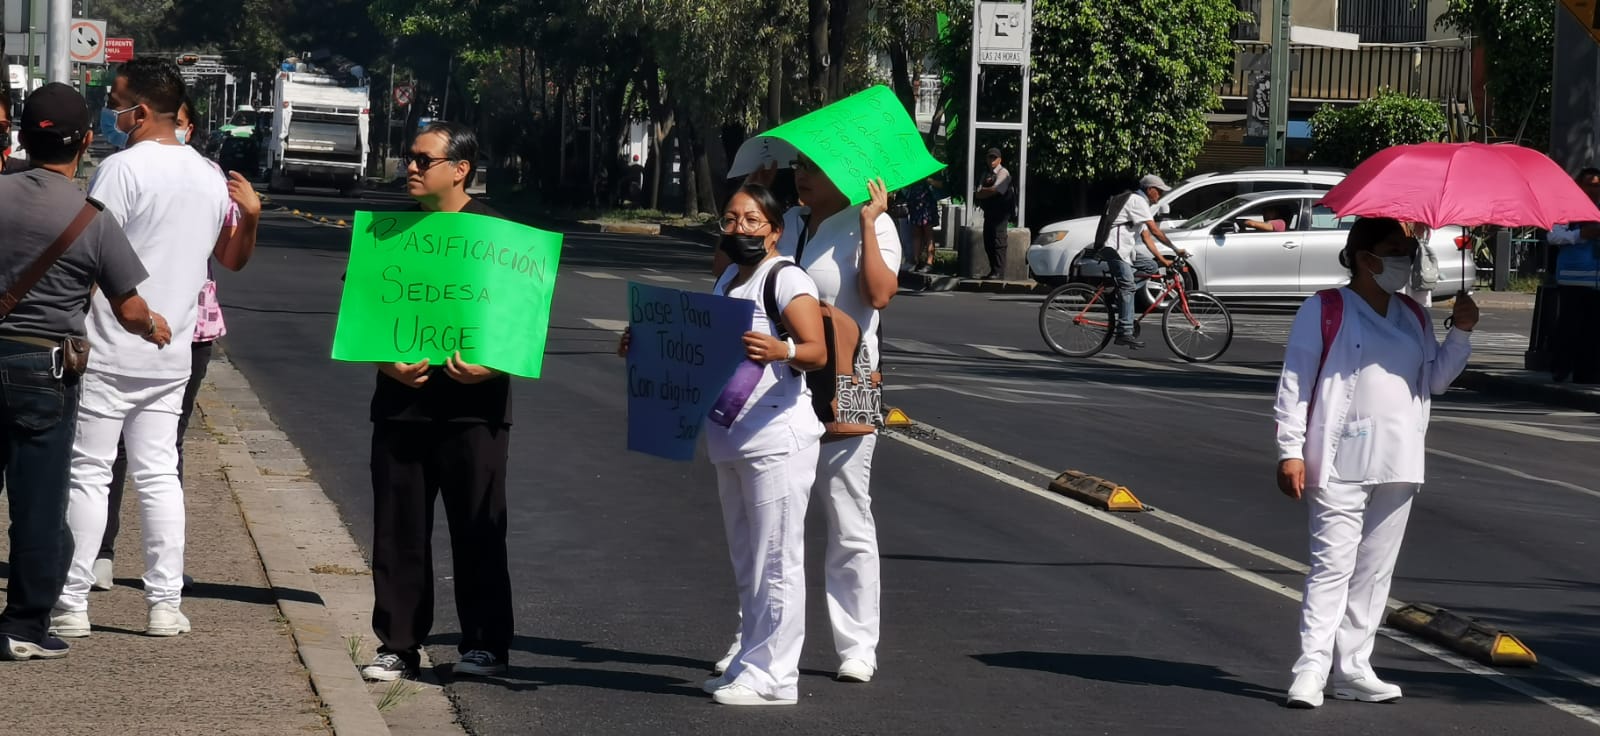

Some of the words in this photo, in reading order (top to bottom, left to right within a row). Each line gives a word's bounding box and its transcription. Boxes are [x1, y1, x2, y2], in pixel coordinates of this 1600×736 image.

[982, 52, 993, 61] LAS
[994, 52, 1001, 61] 24
[1003, 52, 1021, 61] HORAS
[381, 264, 491, 304] SEDESA
[631, 286, 673, 325] Base
[680, 290, 711, 328] Para
[393, 315, 480, 353] URGE
[656, 330, 705, 366] Todos
